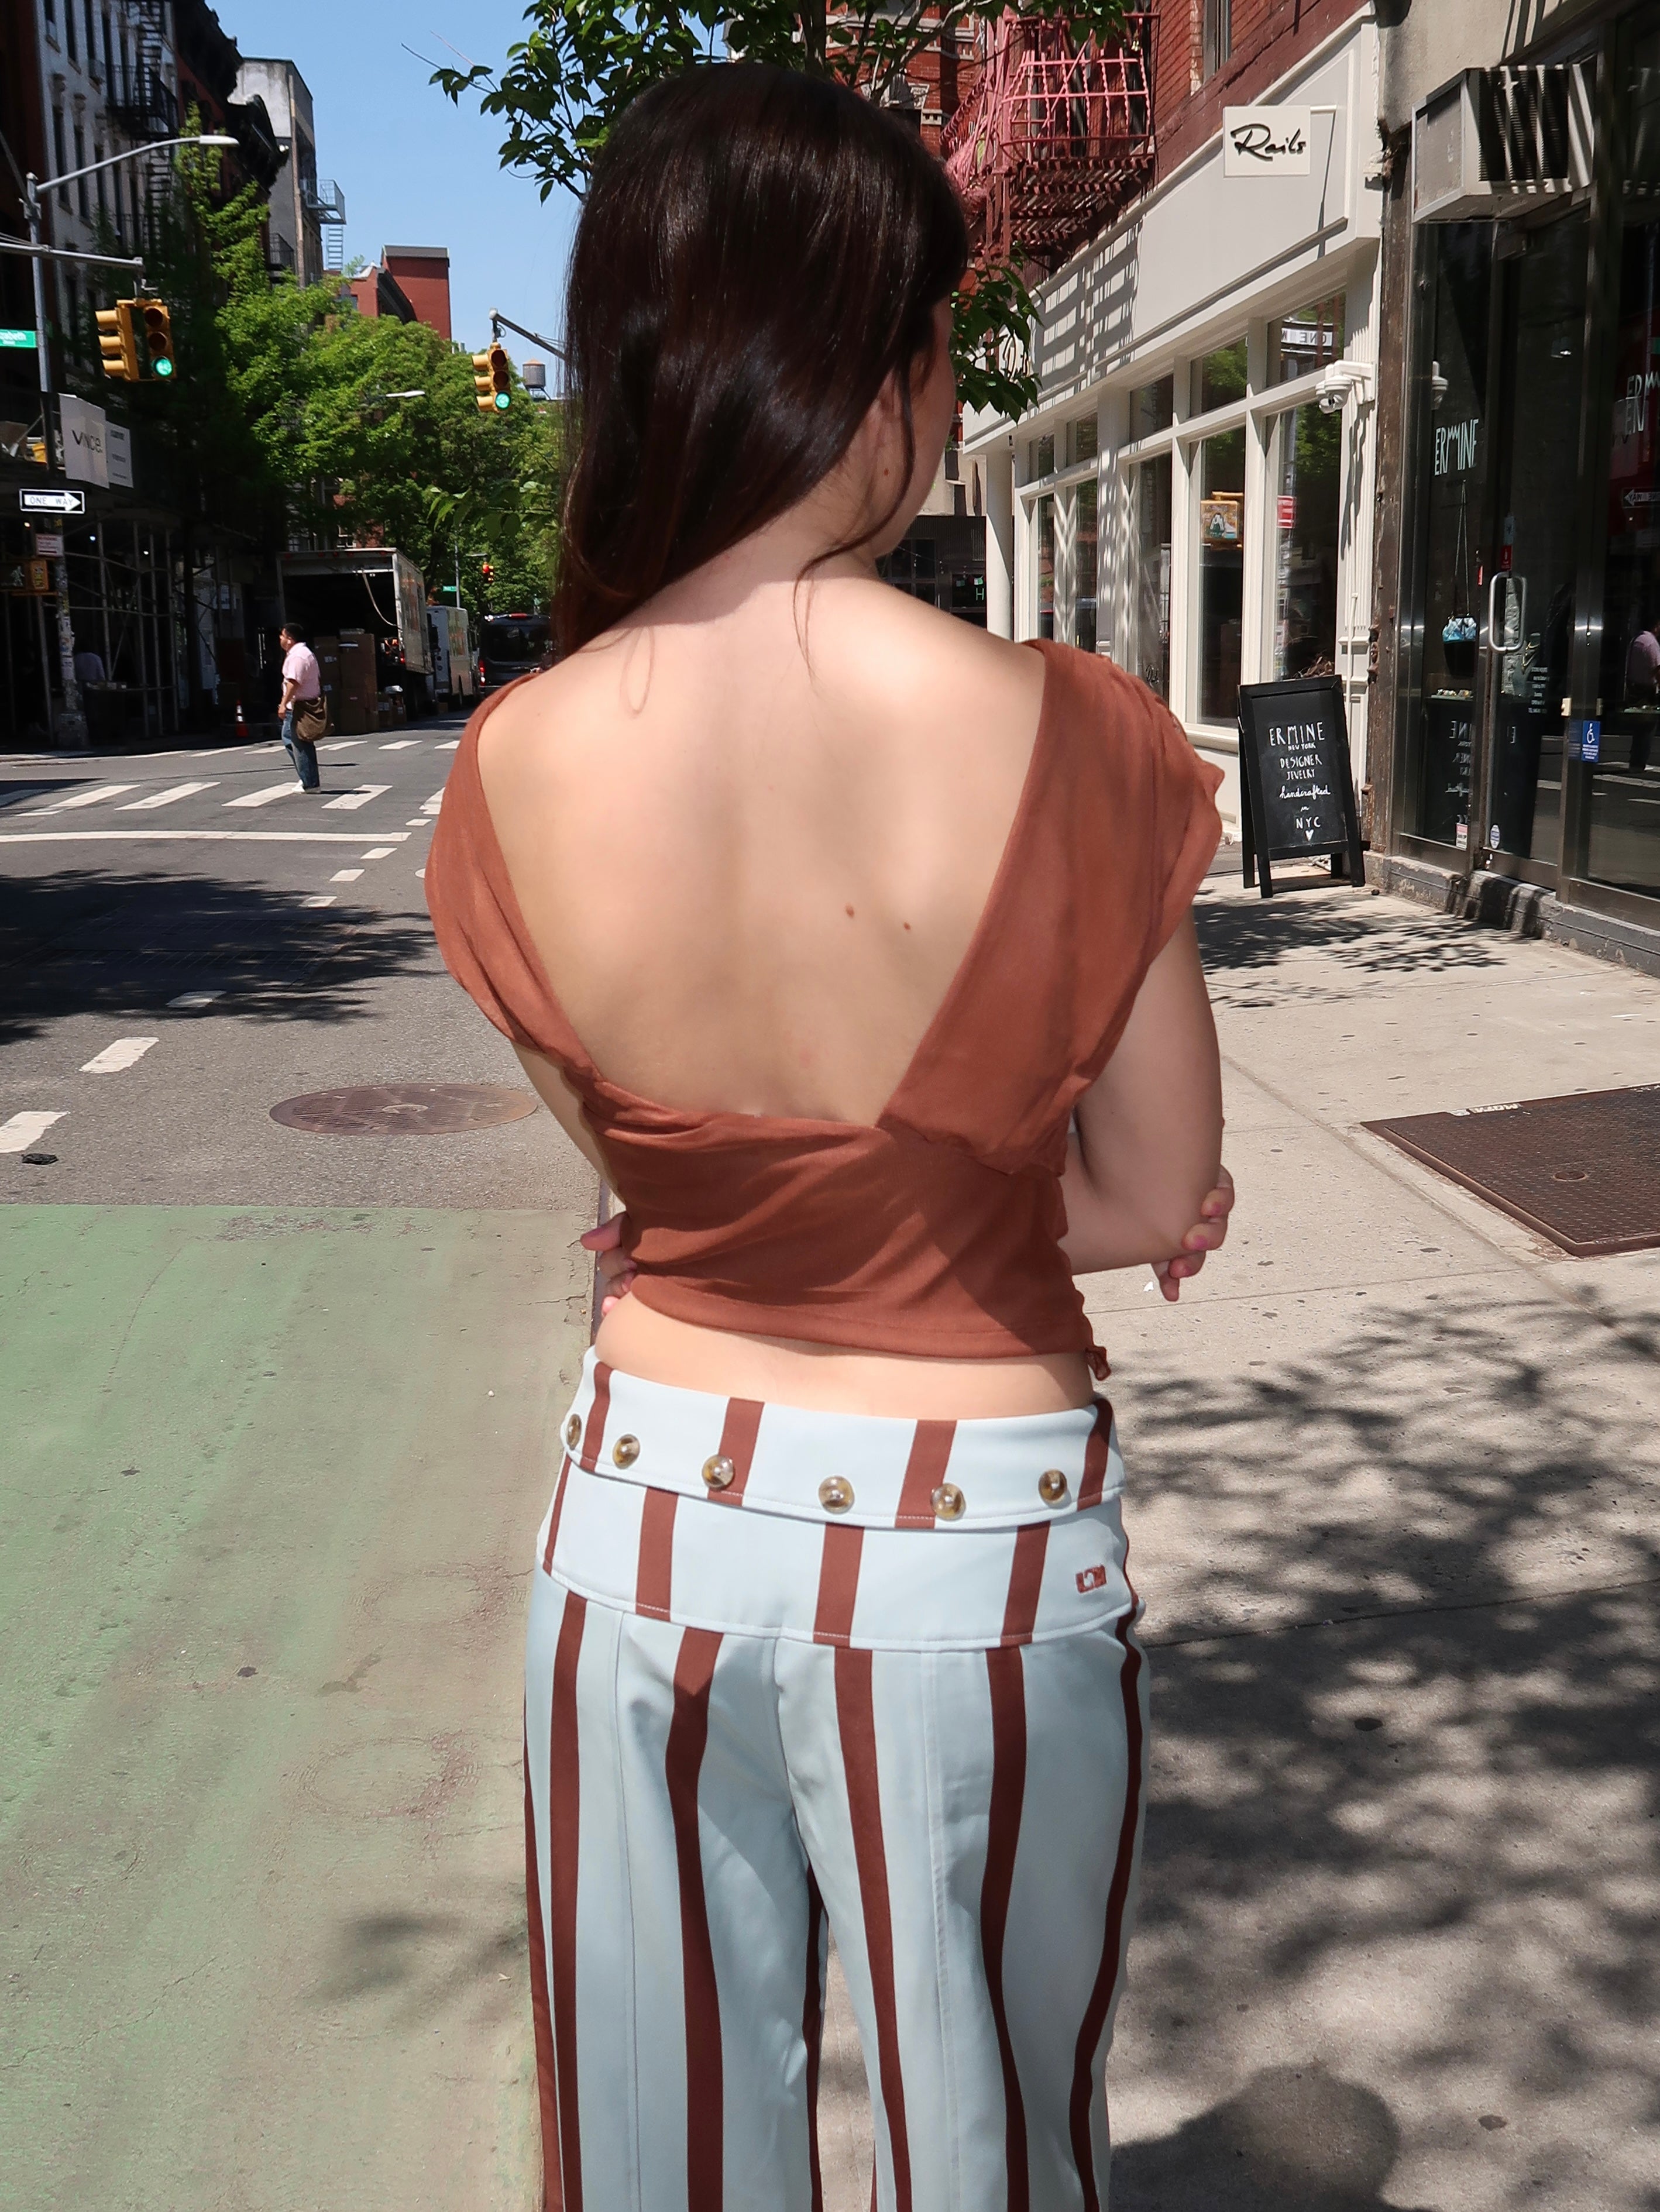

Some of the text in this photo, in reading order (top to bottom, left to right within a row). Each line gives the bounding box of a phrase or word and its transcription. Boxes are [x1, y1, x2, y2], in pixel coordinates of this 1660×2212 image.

[1231, 123, 1306, 161] Rails
[30, 496, 47, 505] ONE
[1269, 722, 1325, 746] ERMINE
[1280, 754, 1322, 769] DESIGNER
[1280, 785, 1331, 800] handcrafted
[1296, 817, 1321, 828] NYC
